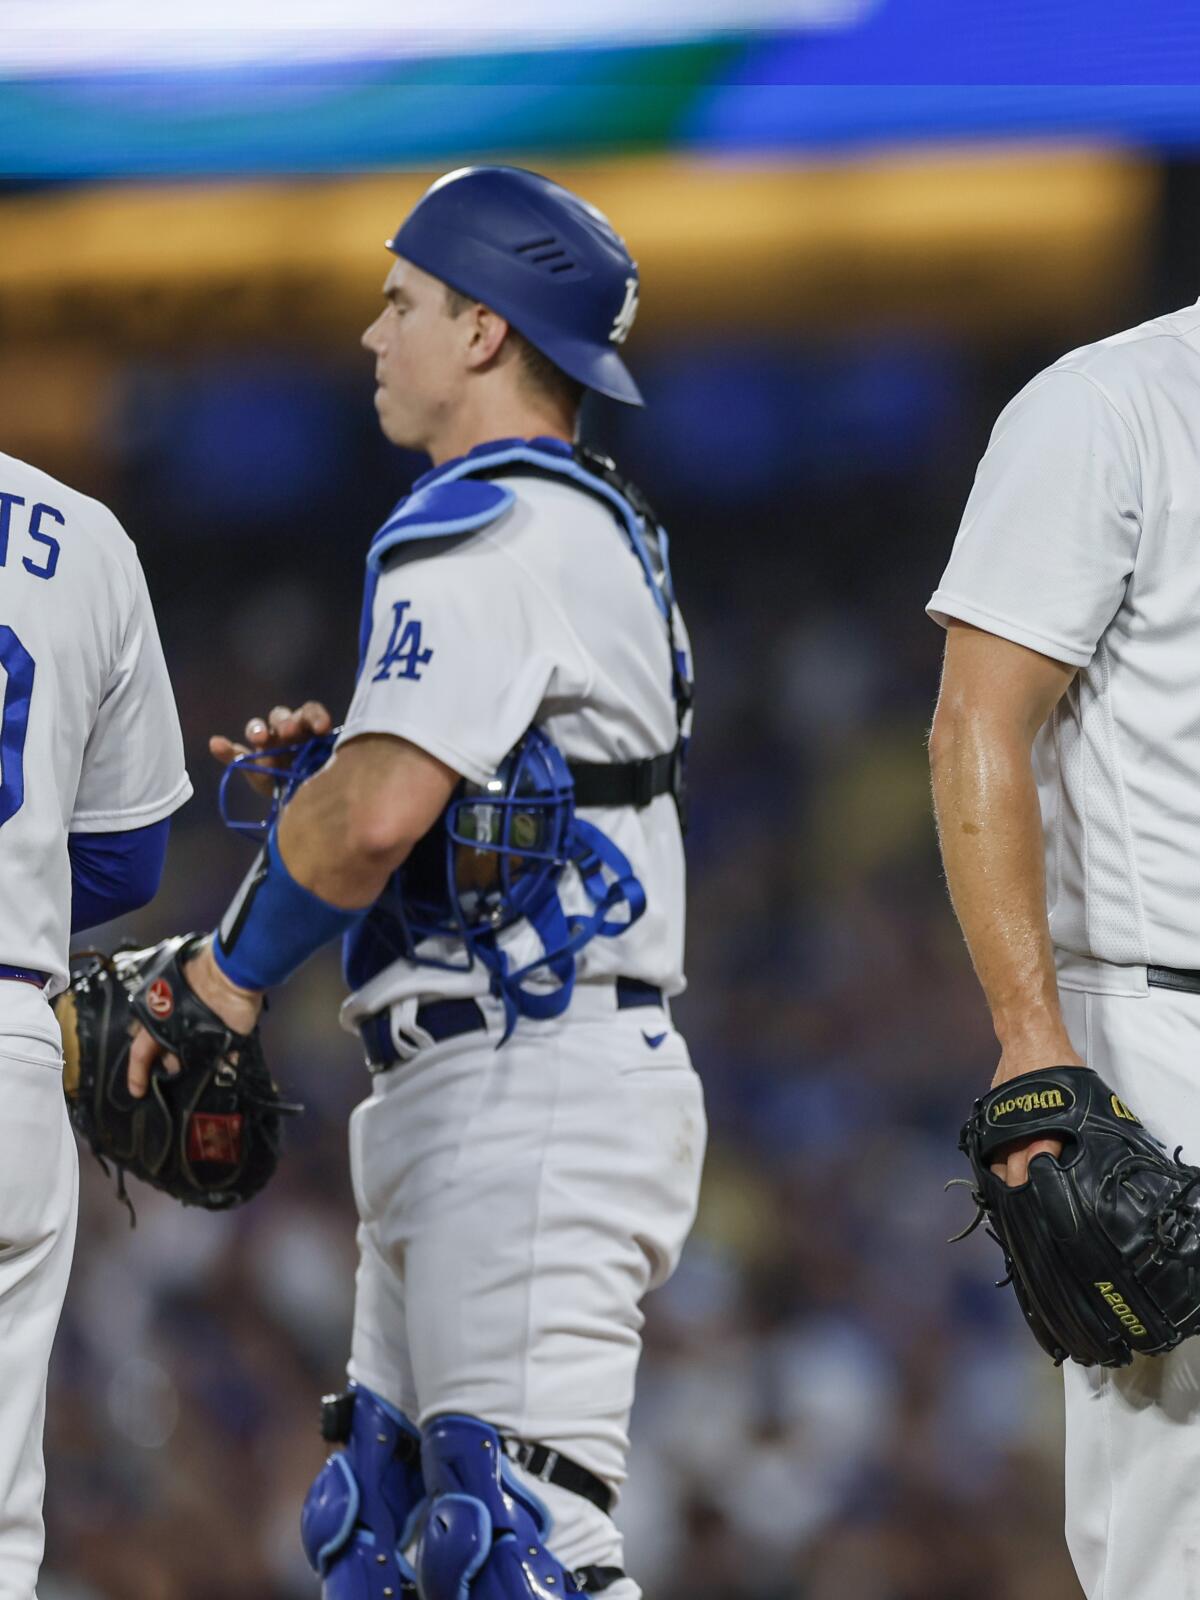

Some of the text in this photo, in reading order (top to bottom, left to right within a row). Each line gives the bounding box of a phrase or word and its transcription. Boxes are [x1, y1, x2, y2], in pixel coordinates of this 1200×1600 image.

[372, 600, 434, 682] LA
[993, 1089, 1065, 1121] Wilson
[1094, 1281, 1147, 1336] A2000
